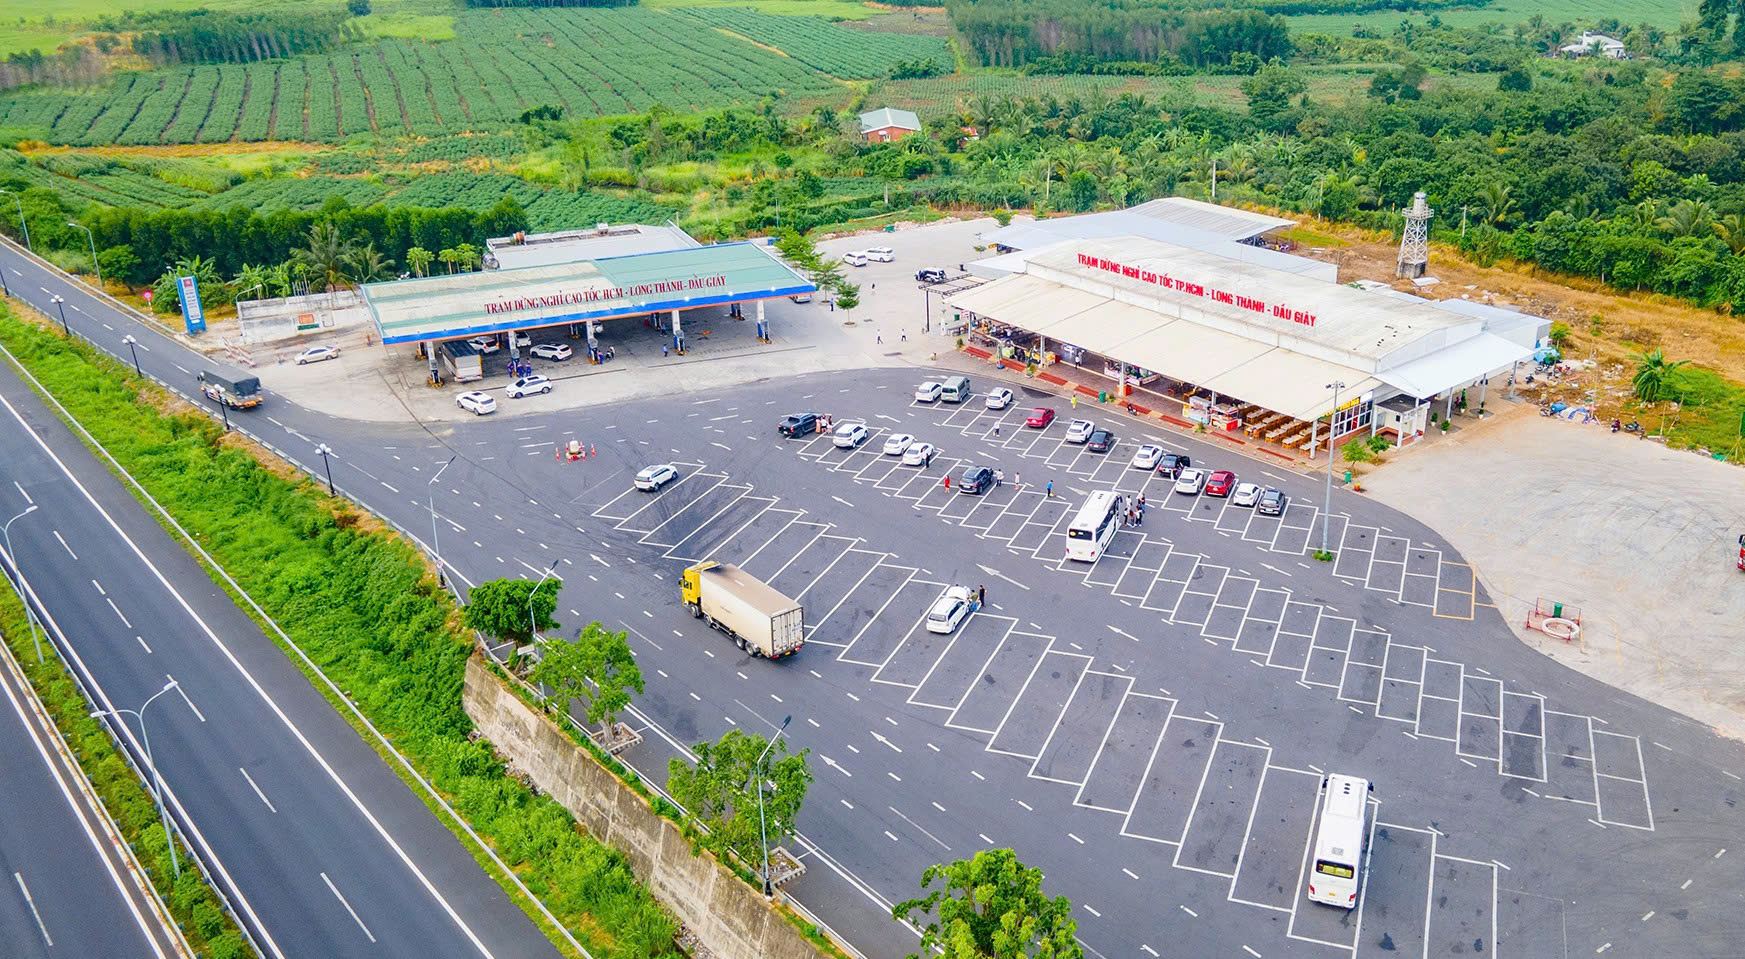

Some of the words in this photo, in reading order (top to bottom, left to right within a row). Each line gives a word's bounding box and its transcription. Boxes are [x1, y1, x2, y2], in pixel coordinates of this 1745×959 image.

[565, 292, 582, 304] CAO
[584, 285, 601, 302] TỐC
[602, 287, 623, 300] HCM
[629, 283, 652, 297] LONG
[654, 278, 683, 293] THÀNH
[1077, 253, 1098, 269] TRẠM
[1100, 258, 1121, 274] DỪNG
[1142, 271, 1157, 284] CAO
[1159, 273, 1173, 288] TỐC
[1175, 279, 1203, 297] TP.HCM
[1211, 289, 1233, 305] LONG
[1236, 295, 1265, 313] THÀNH
